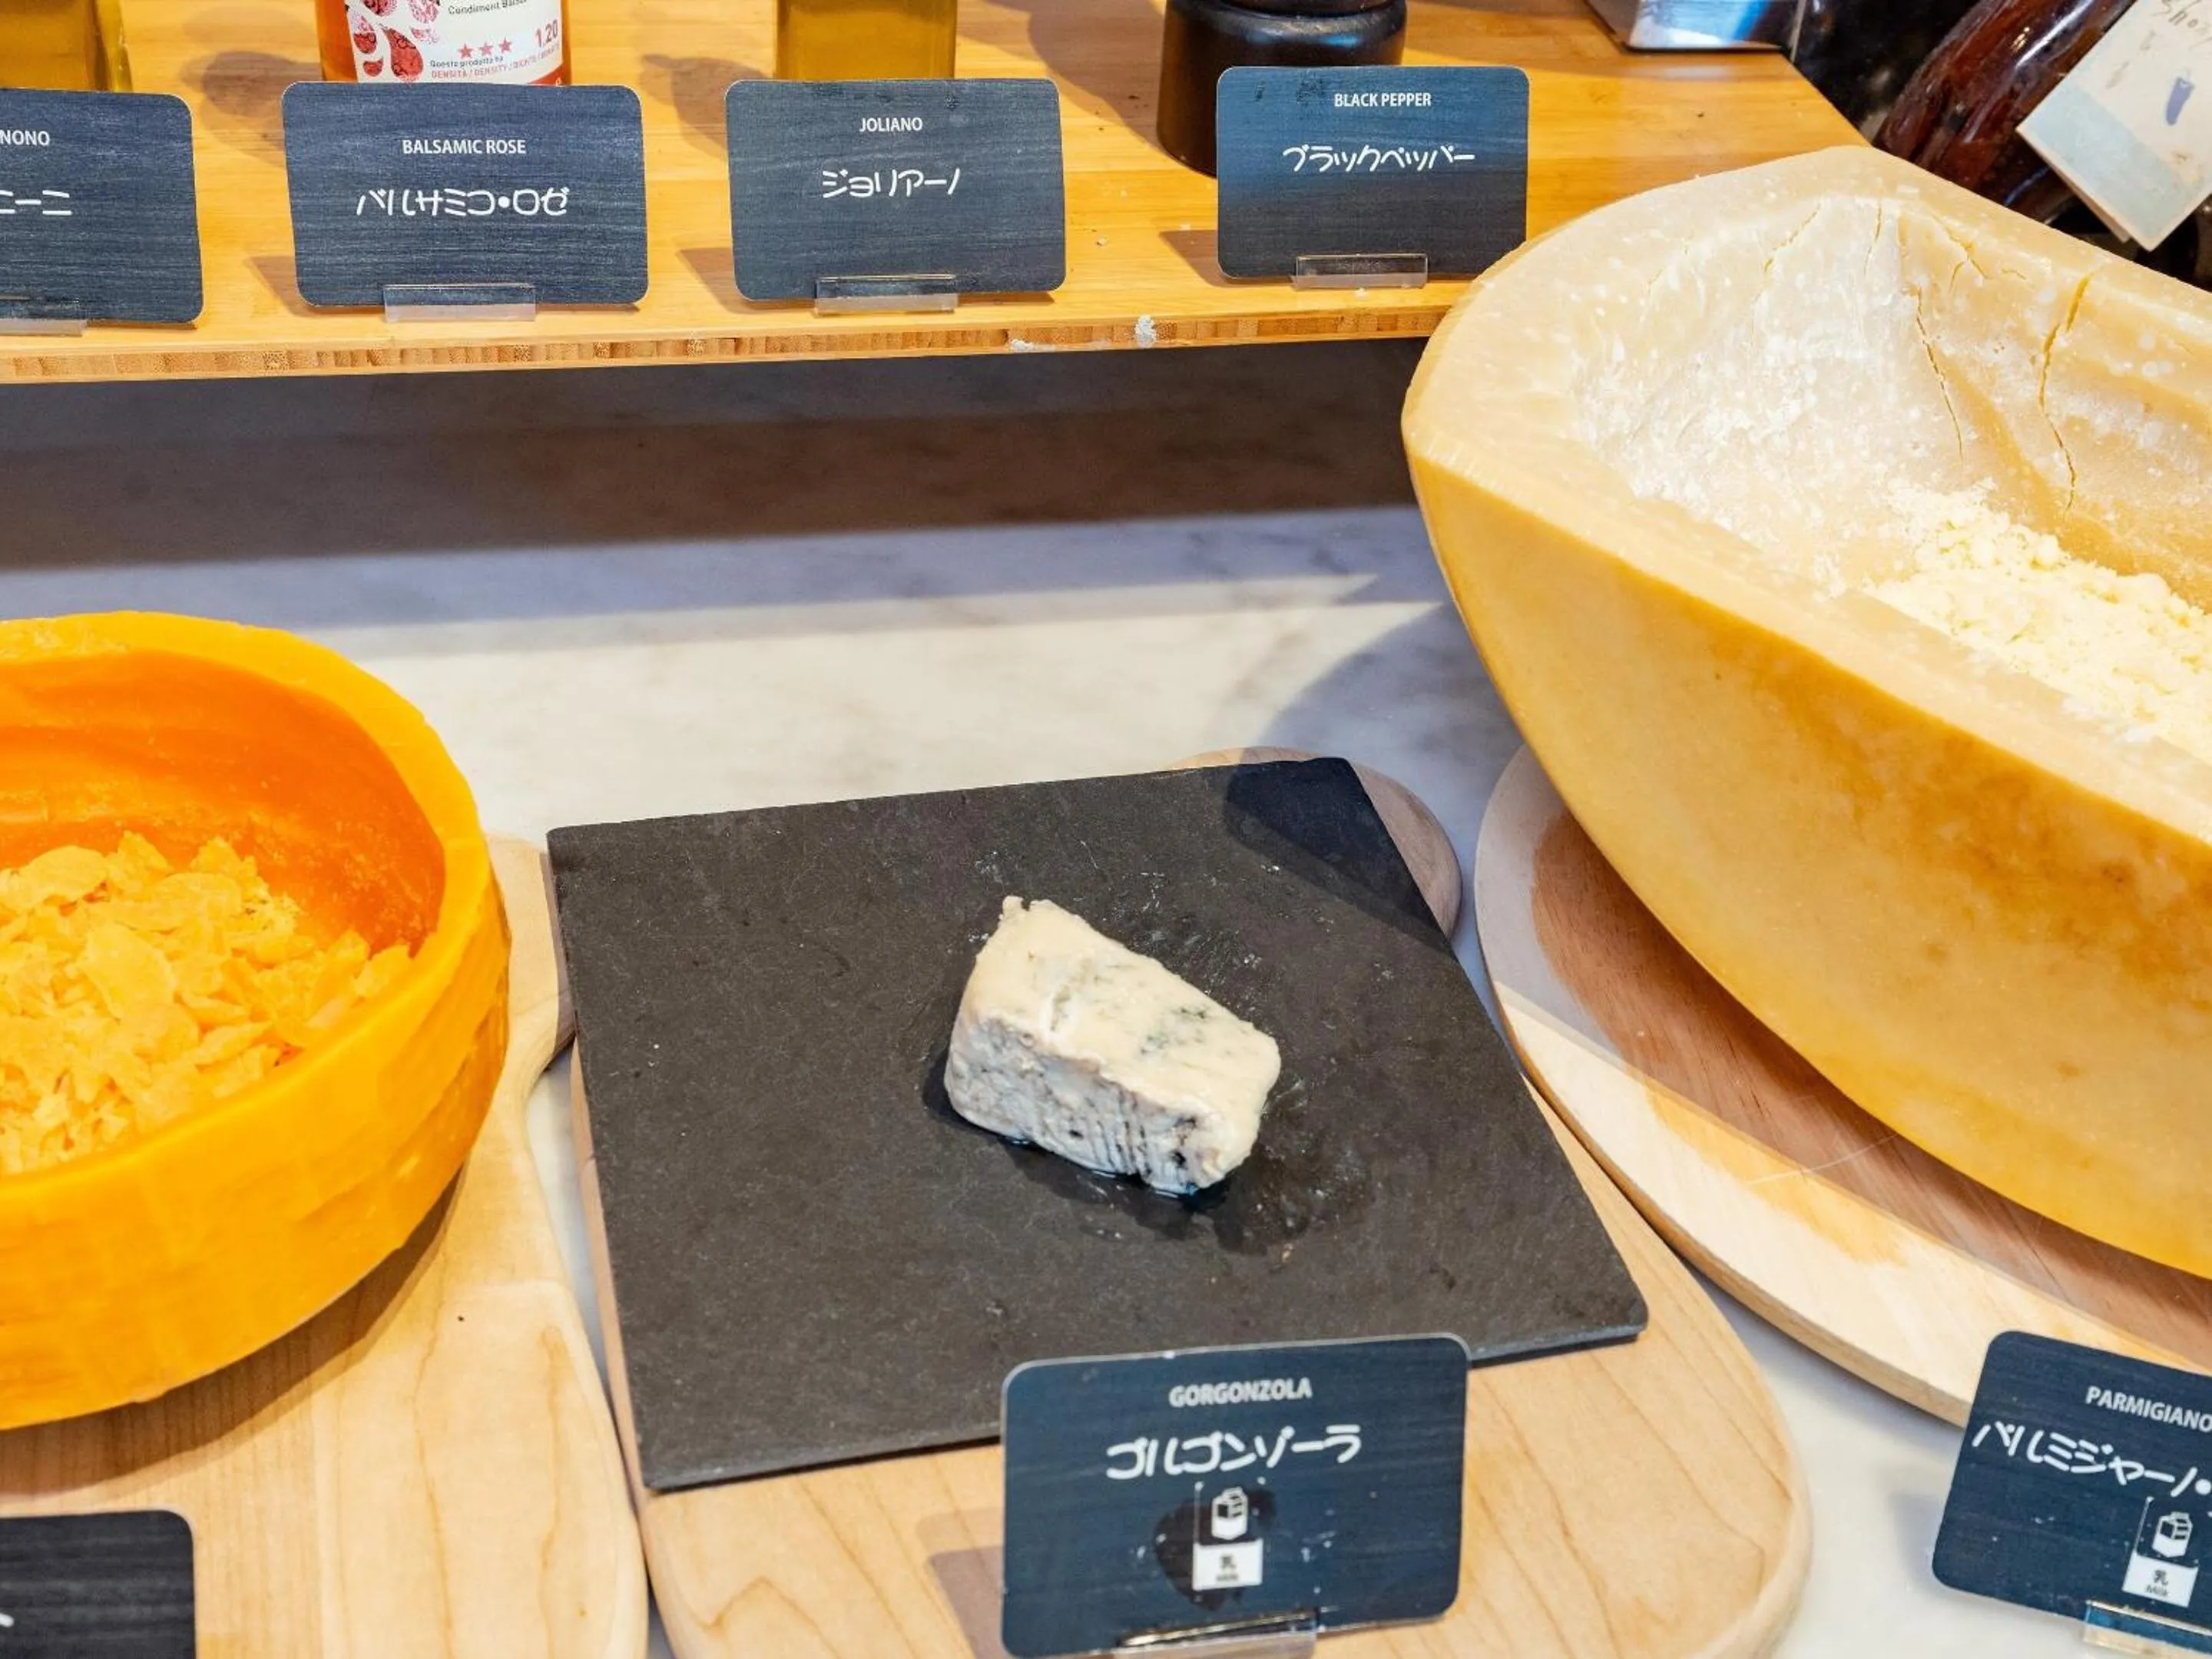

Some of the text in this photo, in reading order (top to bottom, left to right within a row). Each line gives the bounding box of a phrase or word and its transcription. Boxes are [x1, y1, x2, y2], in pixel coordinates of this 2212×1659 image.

[448, 3, 500, 15] Condiment
[535, 19, 558, 48] 1.20
[1334, 92, 1432, 108] BLACK PEPPER
[859, 117, 923, 132] JOLIANO
[402, 139, 526, 154] BALSAMIC ROSE
[822, 167, 961, 199] ジョリアーノ
[1169, 1378, 1313, 1408] GORGONZOLA
[2085, 1385, 2212, 1433] PARMIGIANO
[1107, 1425, 1361, 1480] ゴルゴンゾーラ
